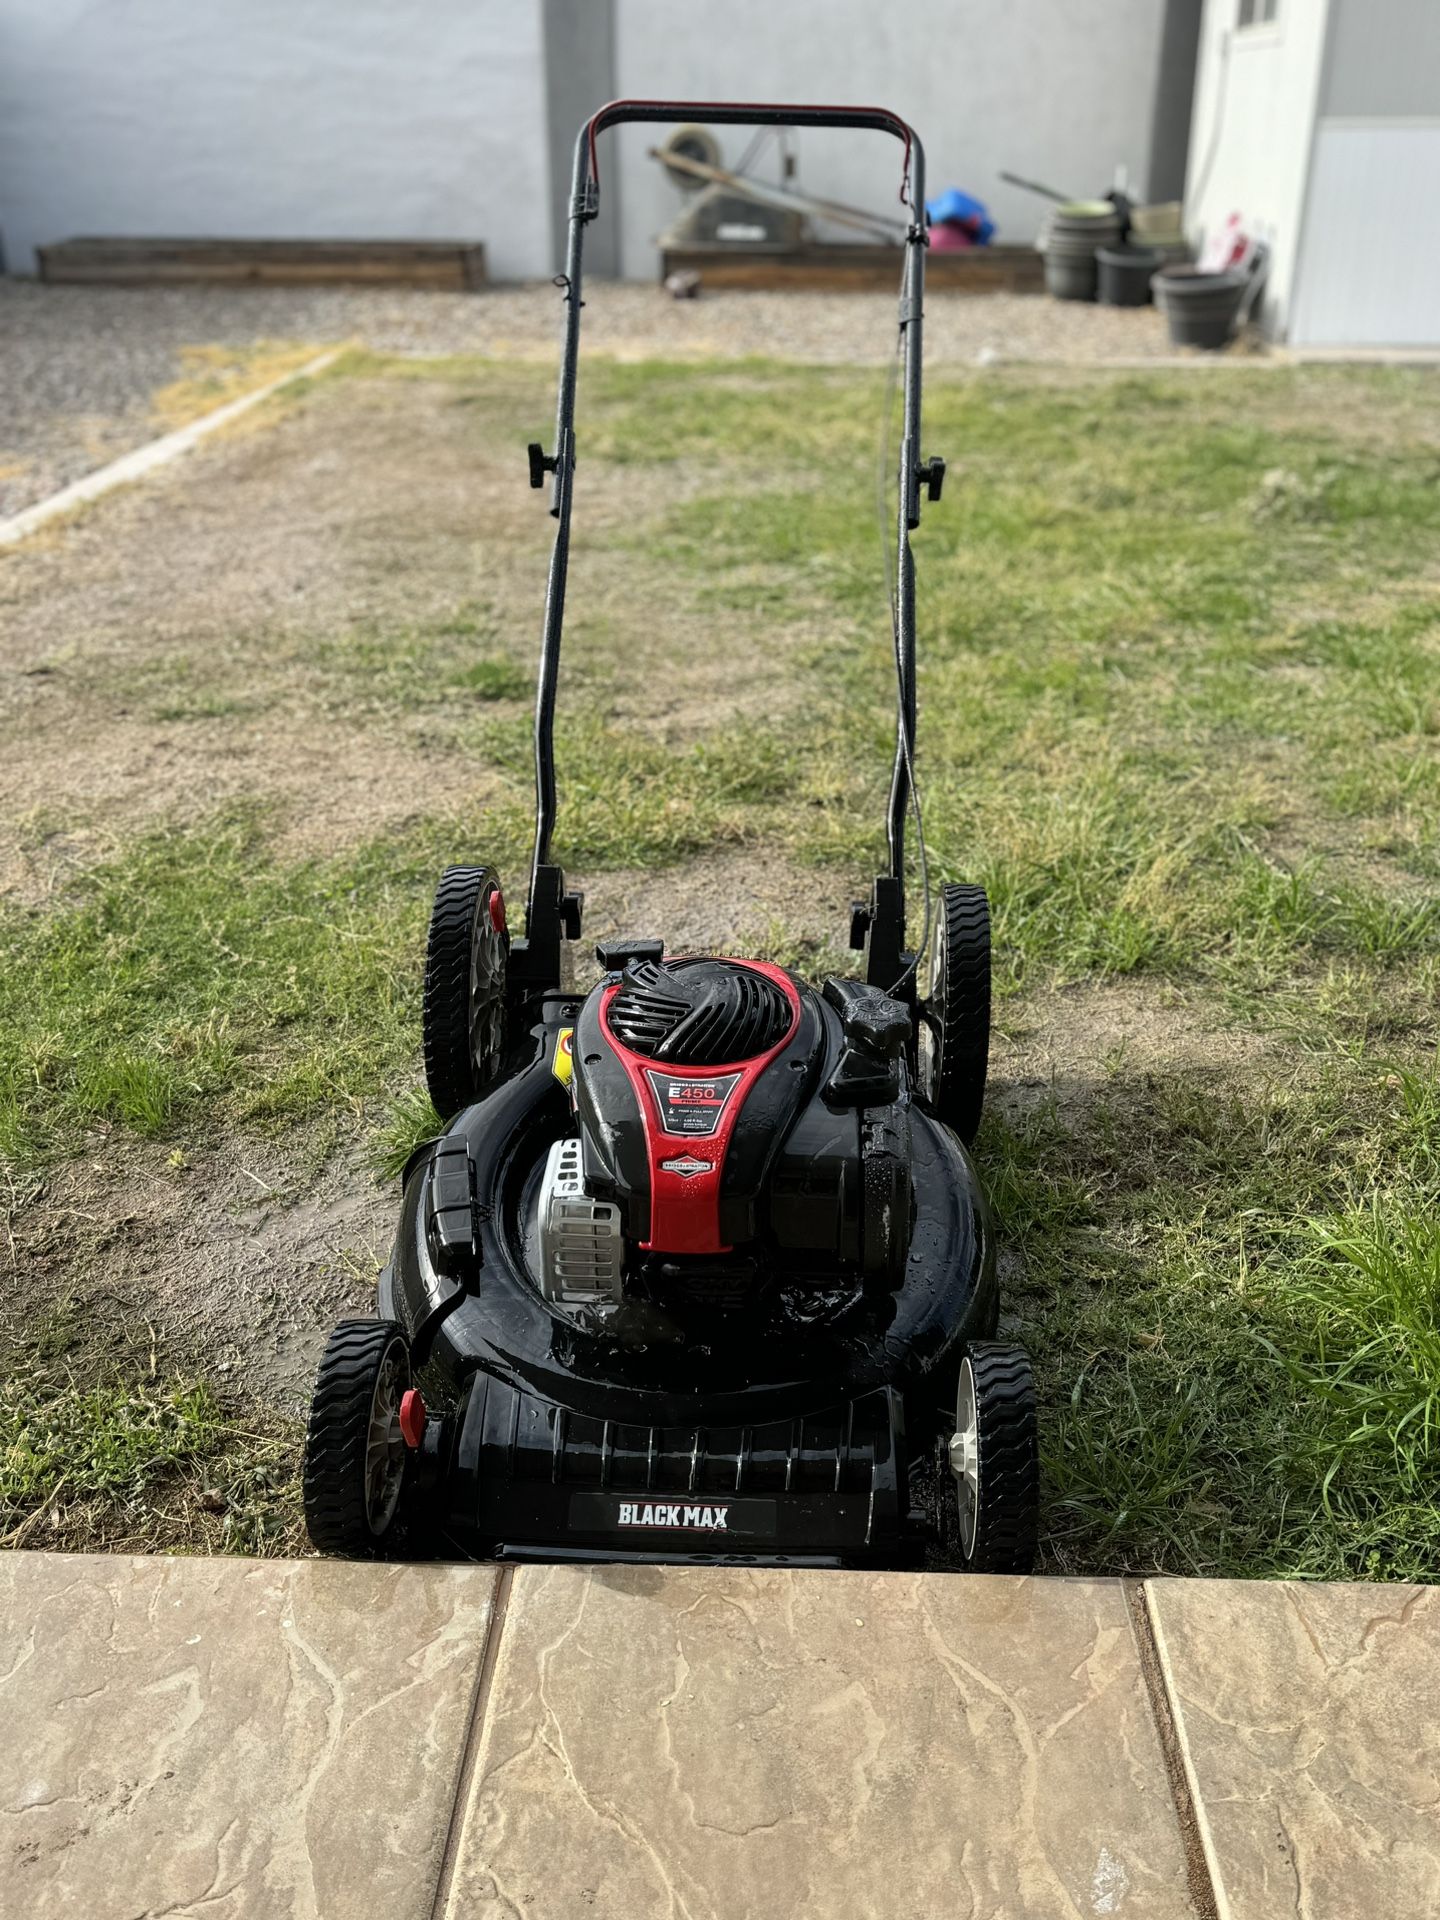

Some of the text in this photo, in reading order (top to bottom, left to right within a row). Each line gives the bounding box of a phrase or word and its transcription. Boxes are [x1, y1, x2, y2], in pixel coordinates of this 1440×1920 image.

[668, 1087, 715, 1098] E450
[618, 1503, 728, 1528] BLACK MAX
